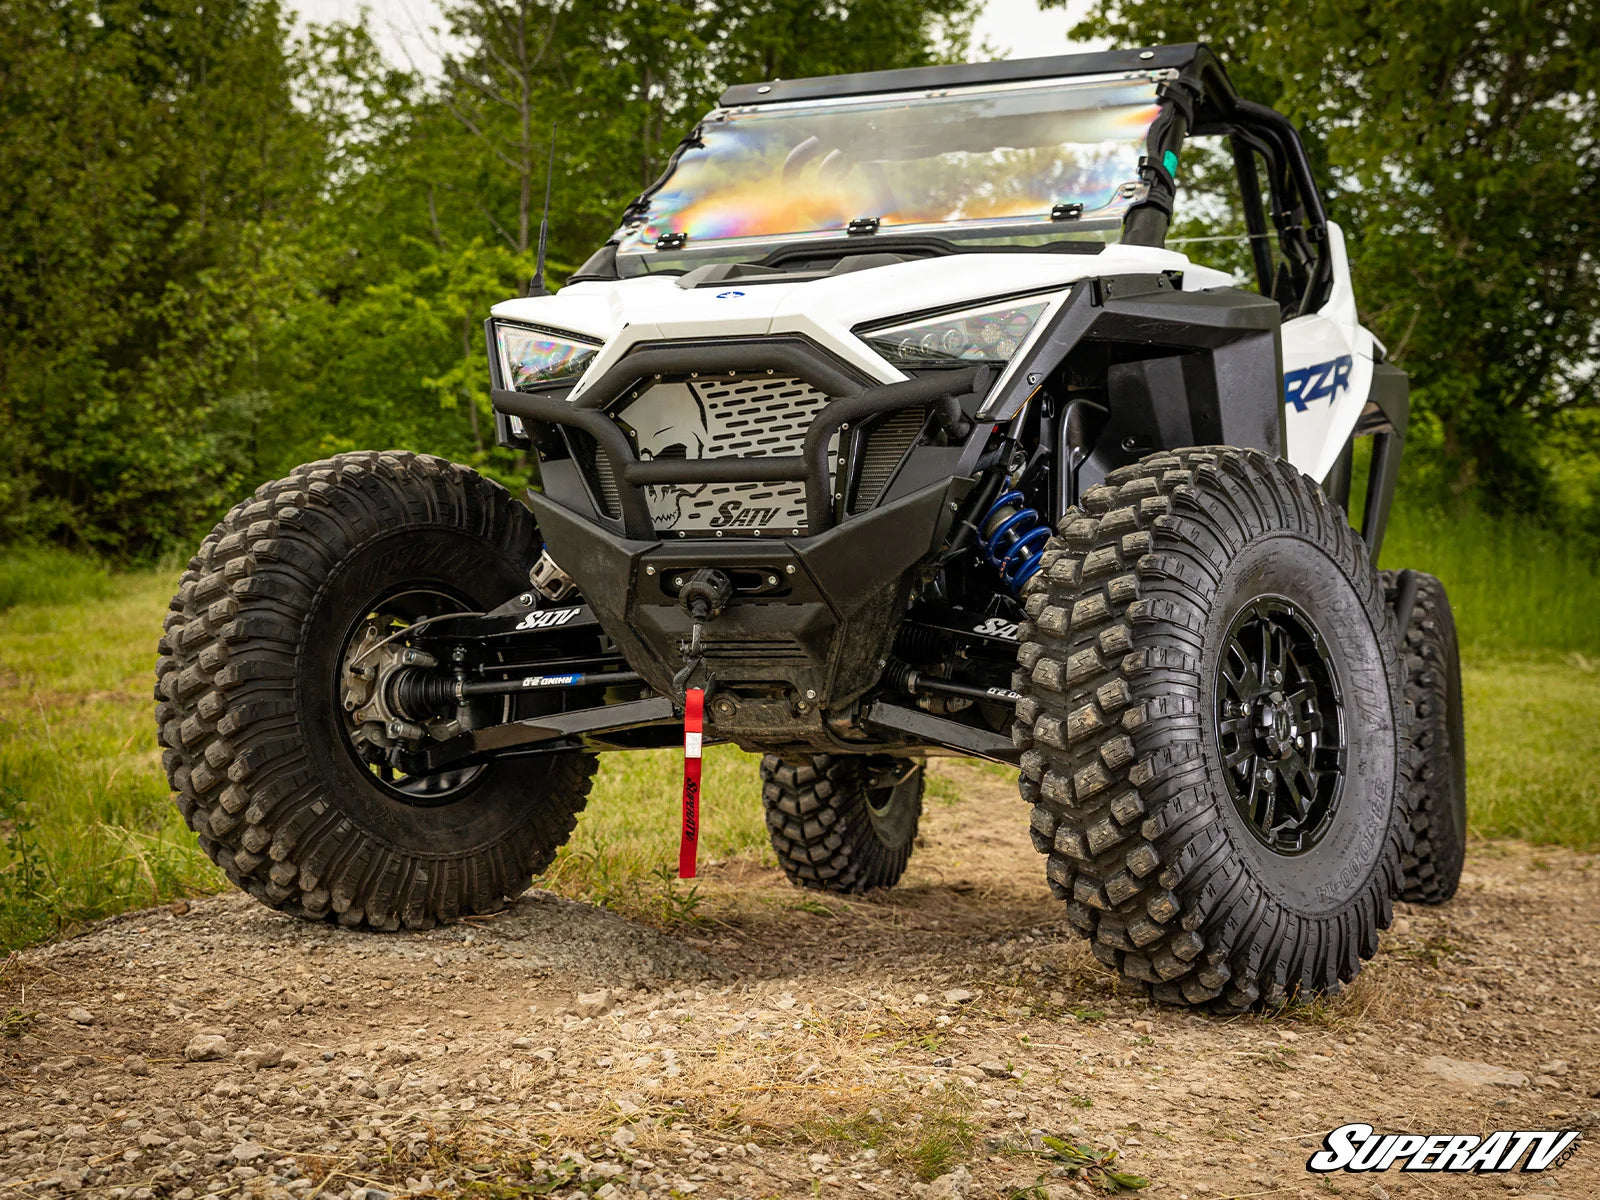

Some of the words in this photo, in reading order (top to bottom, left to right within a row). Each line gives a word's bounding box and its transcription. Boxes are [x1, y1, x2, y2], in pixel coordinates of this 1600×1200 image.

[1284, 354, 1353, 413] RZR
[710, 500, 781, 527] SATV
[516, 608, 581, 630] SATV
[973, 618, 1020, 640] SA
[541, 676, 573, 686] RHINO
[686, 777, 698, 840] SUPERATV
